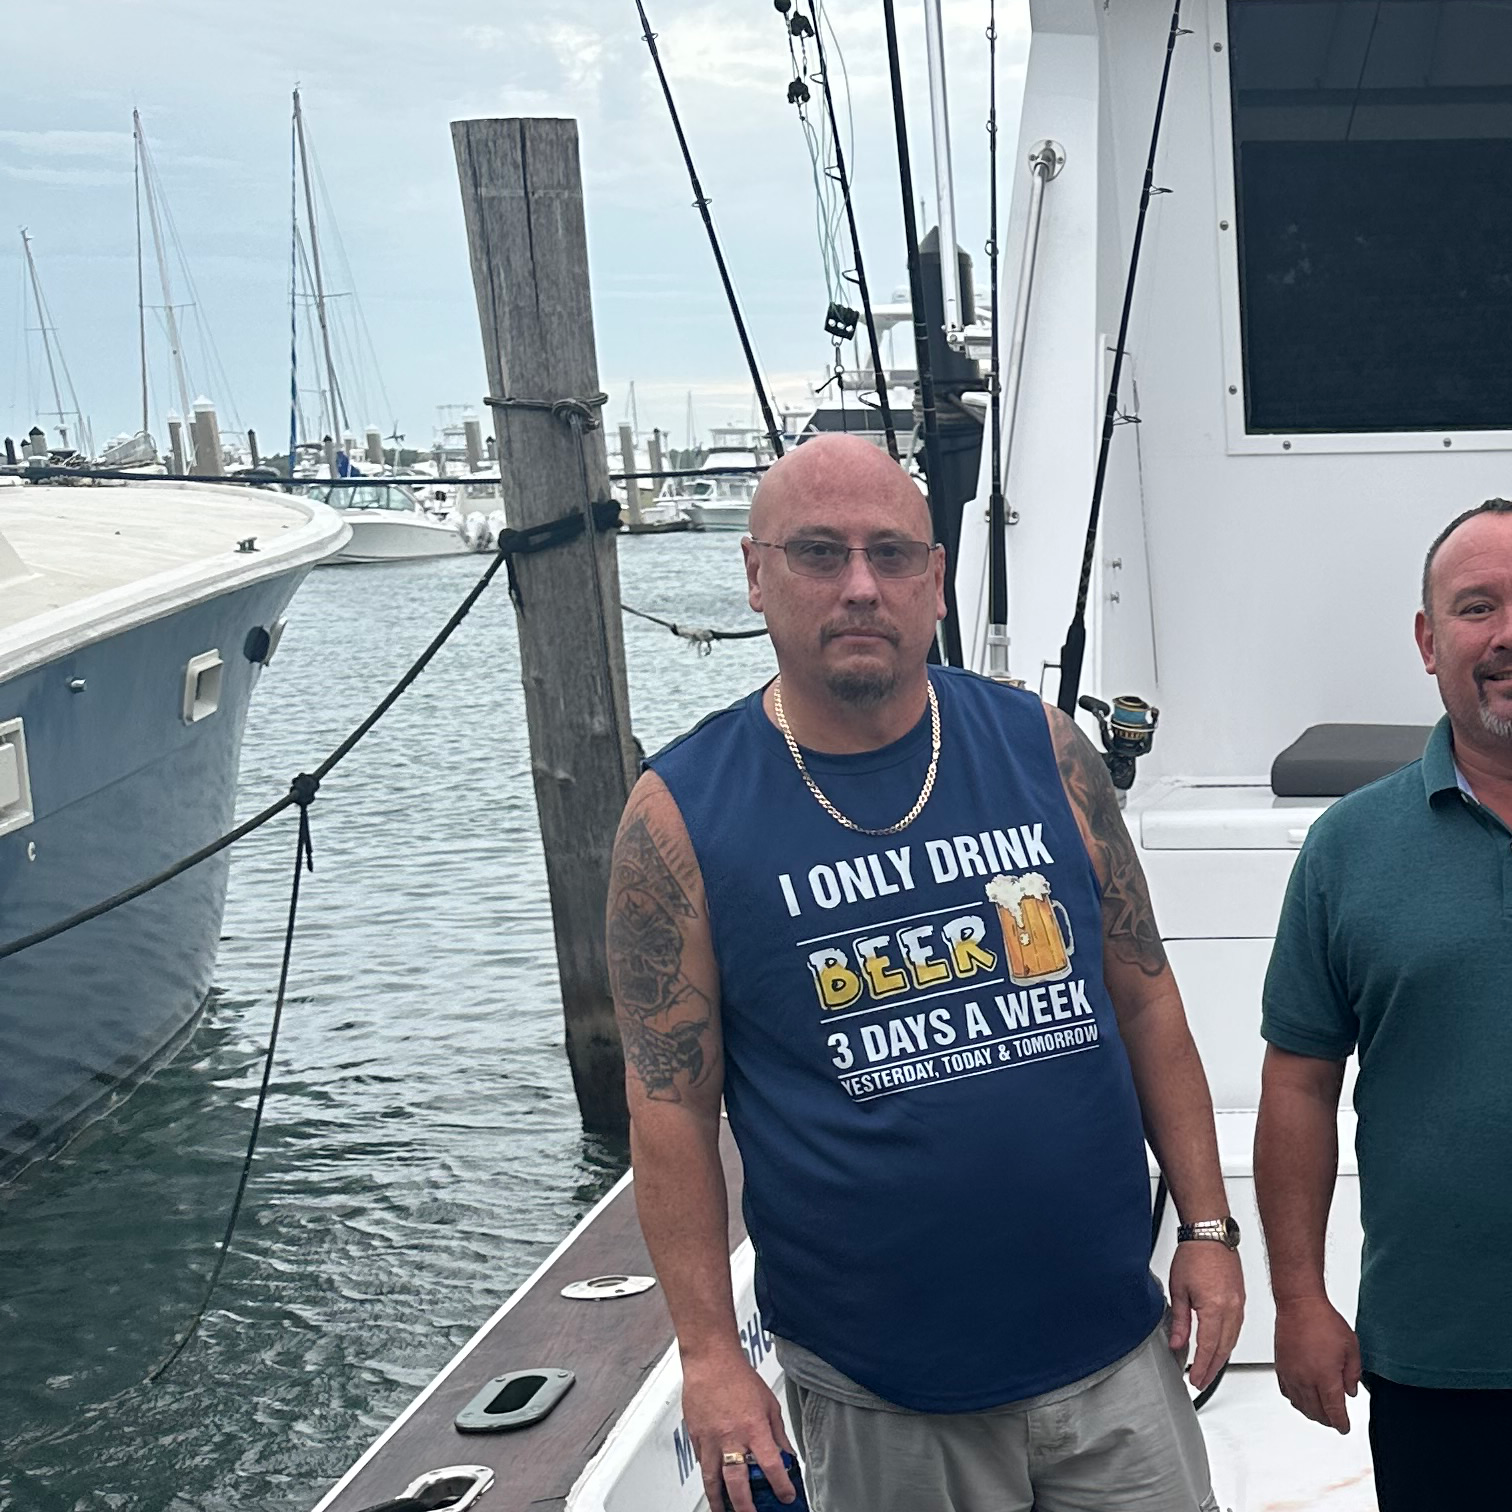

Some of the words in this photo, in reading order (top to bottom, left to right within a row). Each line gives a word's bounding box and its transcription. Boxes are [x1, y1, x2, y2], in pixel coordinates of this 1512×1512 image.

[778, 873, 802, 918] I
[808, 846, 916, 909] ONLY
[925, 822, 1054, 885] DRINK
[807, 915, 998, 1011] BEER
[827, 1032, 853, 1070] 3
[860, 1008, 956, 1062] DAYS
[967, 1002, 992, 1038] A
[994, 979, 1093, 1029] WEEK
[840, 1061, 940, 1098] YESTERDAY,
[940, 1046, 992, 1075] TODAY
[998, 1044, 1012, 1062] &
[1012, 1024, 1099, 1059] TOMORROW
